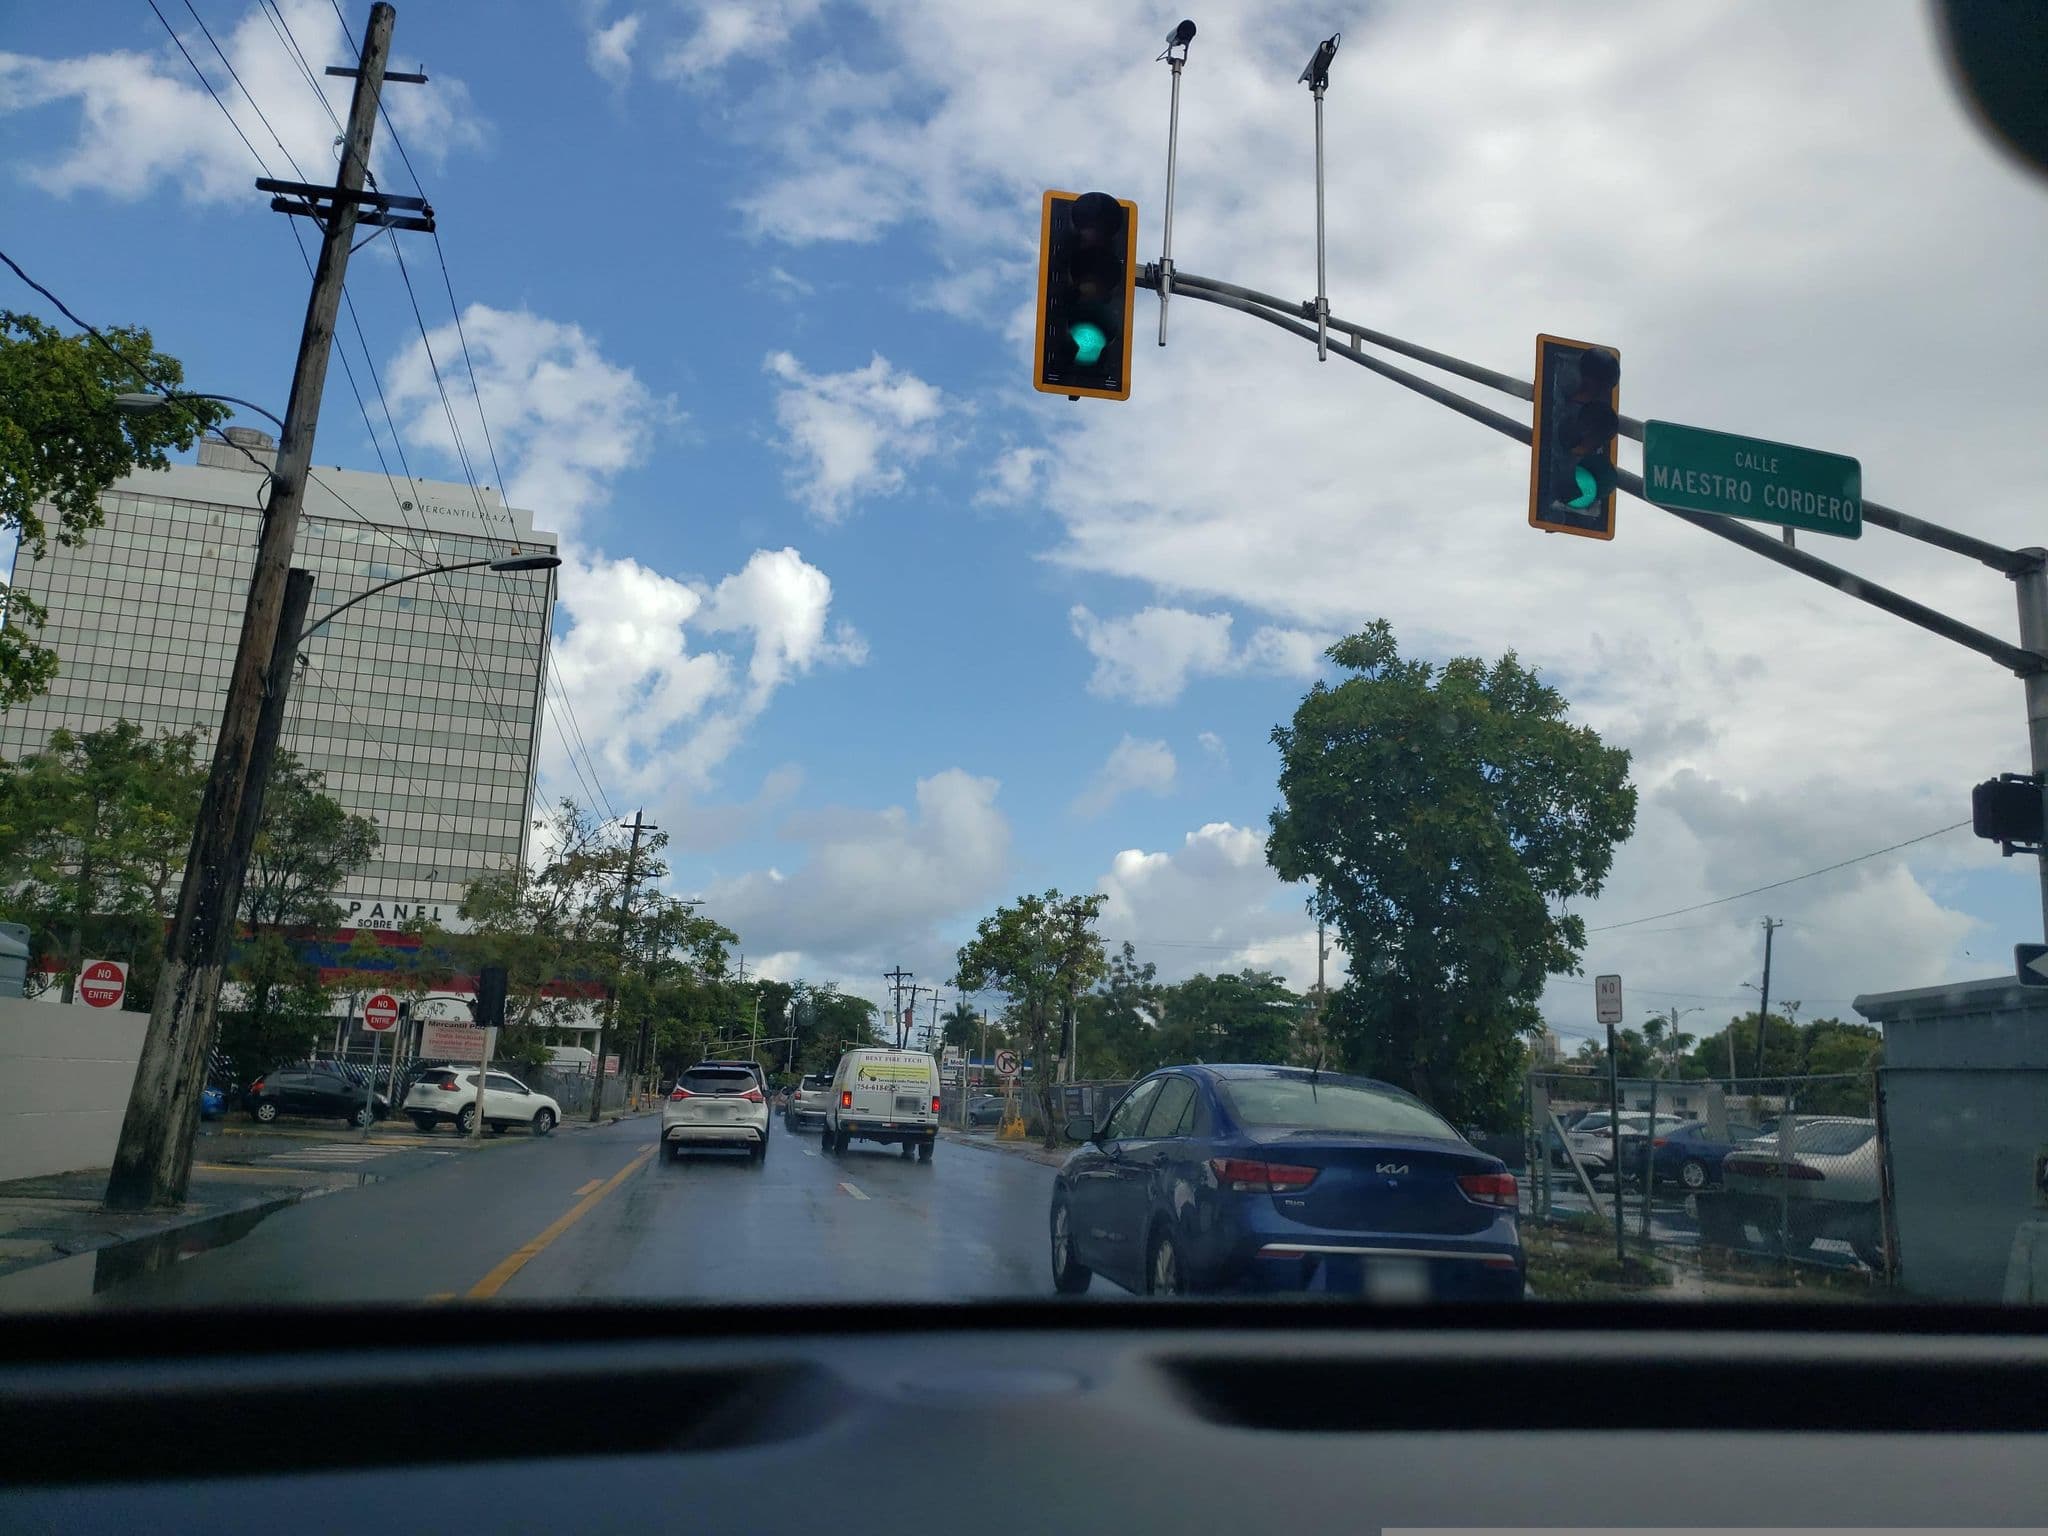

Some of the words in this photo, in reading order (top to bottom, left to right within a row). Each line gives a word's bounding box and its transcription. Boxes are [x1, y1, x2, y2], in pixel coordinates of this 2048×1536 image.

[1735, 452, 1779, 474] CALLE
[1653, 465, 1752, 503] MAESTRO
[1764, 484, 1854, 522] CORDERO
[419, 504, 477, 519] MERCANTIL
[350, 901, 442, 922] PANEL
[358, 918, 393, 929] SOBRE
[97, 968, 112, 979] NO
[1601, 982, 1615, 994] NO
[88, 990, 114, 1000] ENTRE
[377, 1000, 389, 1008] NO
[371, 1016, 391, 1024] ENTRE
[1375, 1162, 1409, 1175] KIA
